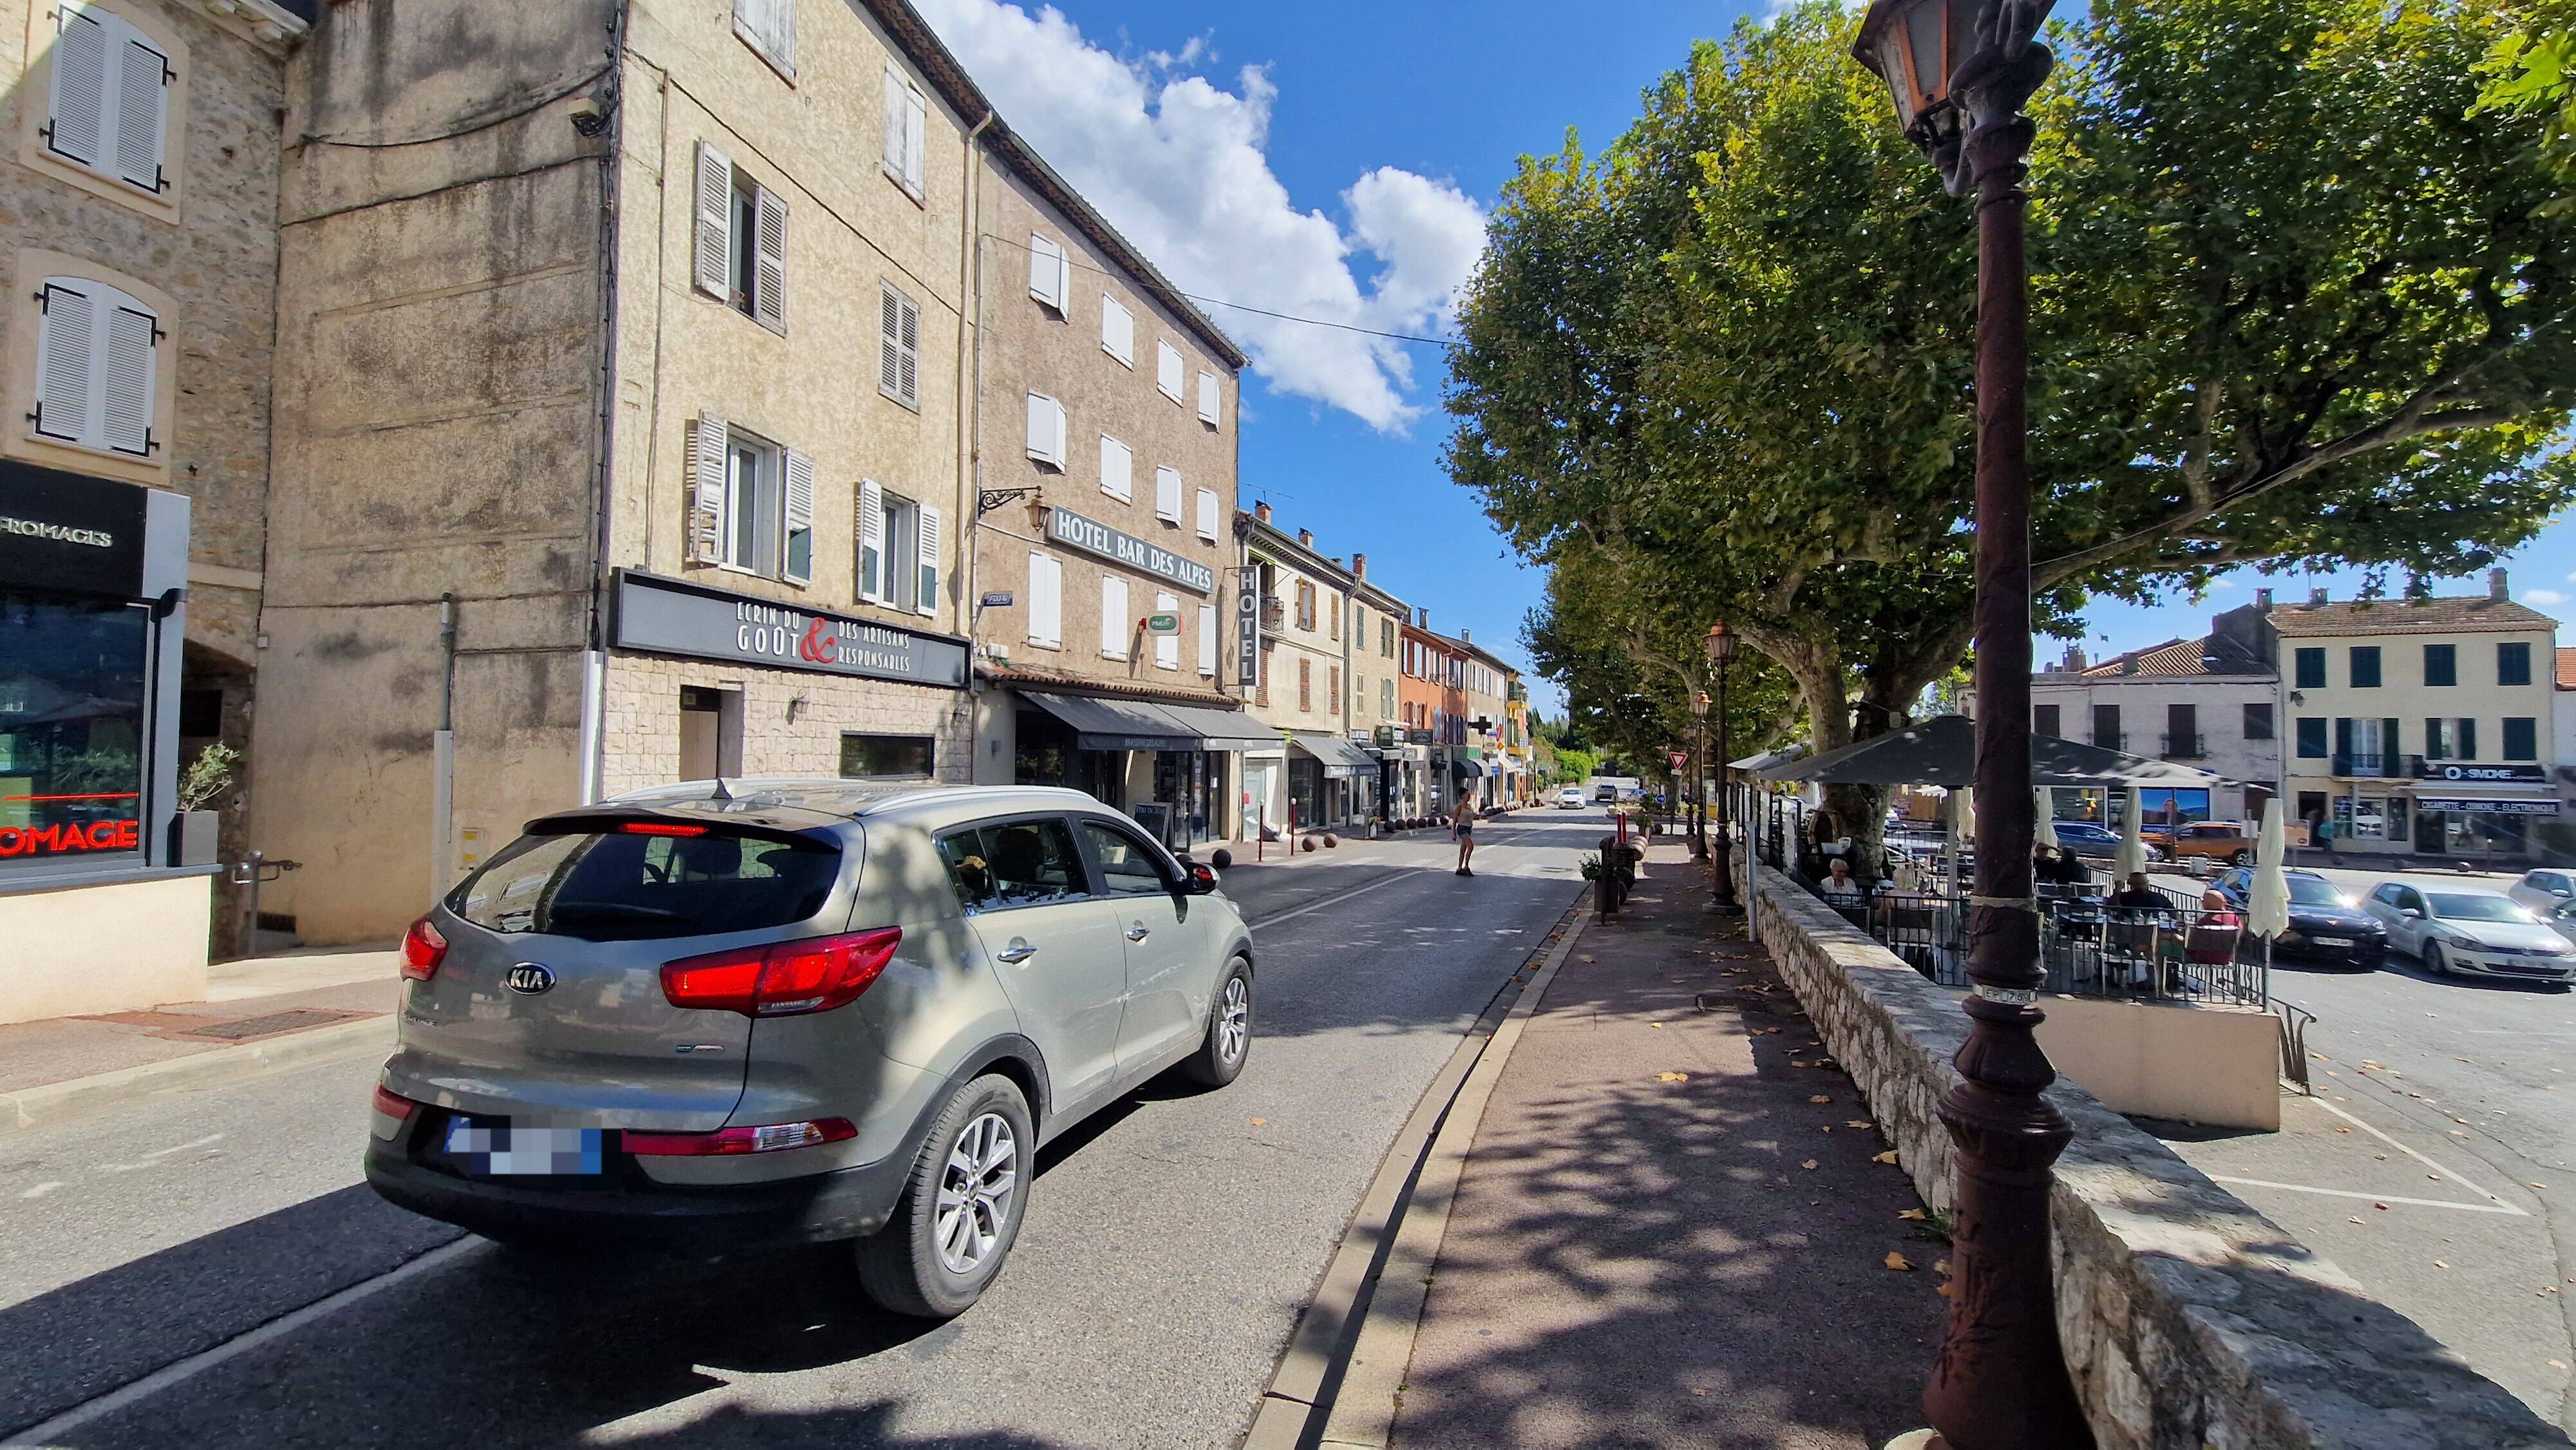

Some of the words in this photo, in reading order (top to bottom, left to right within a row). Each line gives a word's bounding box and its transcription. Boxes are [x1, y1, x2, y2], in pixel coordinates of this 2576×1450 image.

[1057, 511, 1112, 554] HOTEL
[1117, 535, 1145, 566] BAR
[1150, 548, 1174, 576] DES
[1178, 560, 1211, 589] ALPES
[736, 601, 777, 626] ECRIN
[784, 610, 800, 630] DU
[1239, 572, 1256, 680] HOTEL
[737, 625, 800, 657] GOÛT
[838, 621, 858, 641] DES
[862, 626, 910, 650] ARTISANS
[838, 646, 910, 672] RESPONSABLES
[510, 969, 544, 989] KIA
